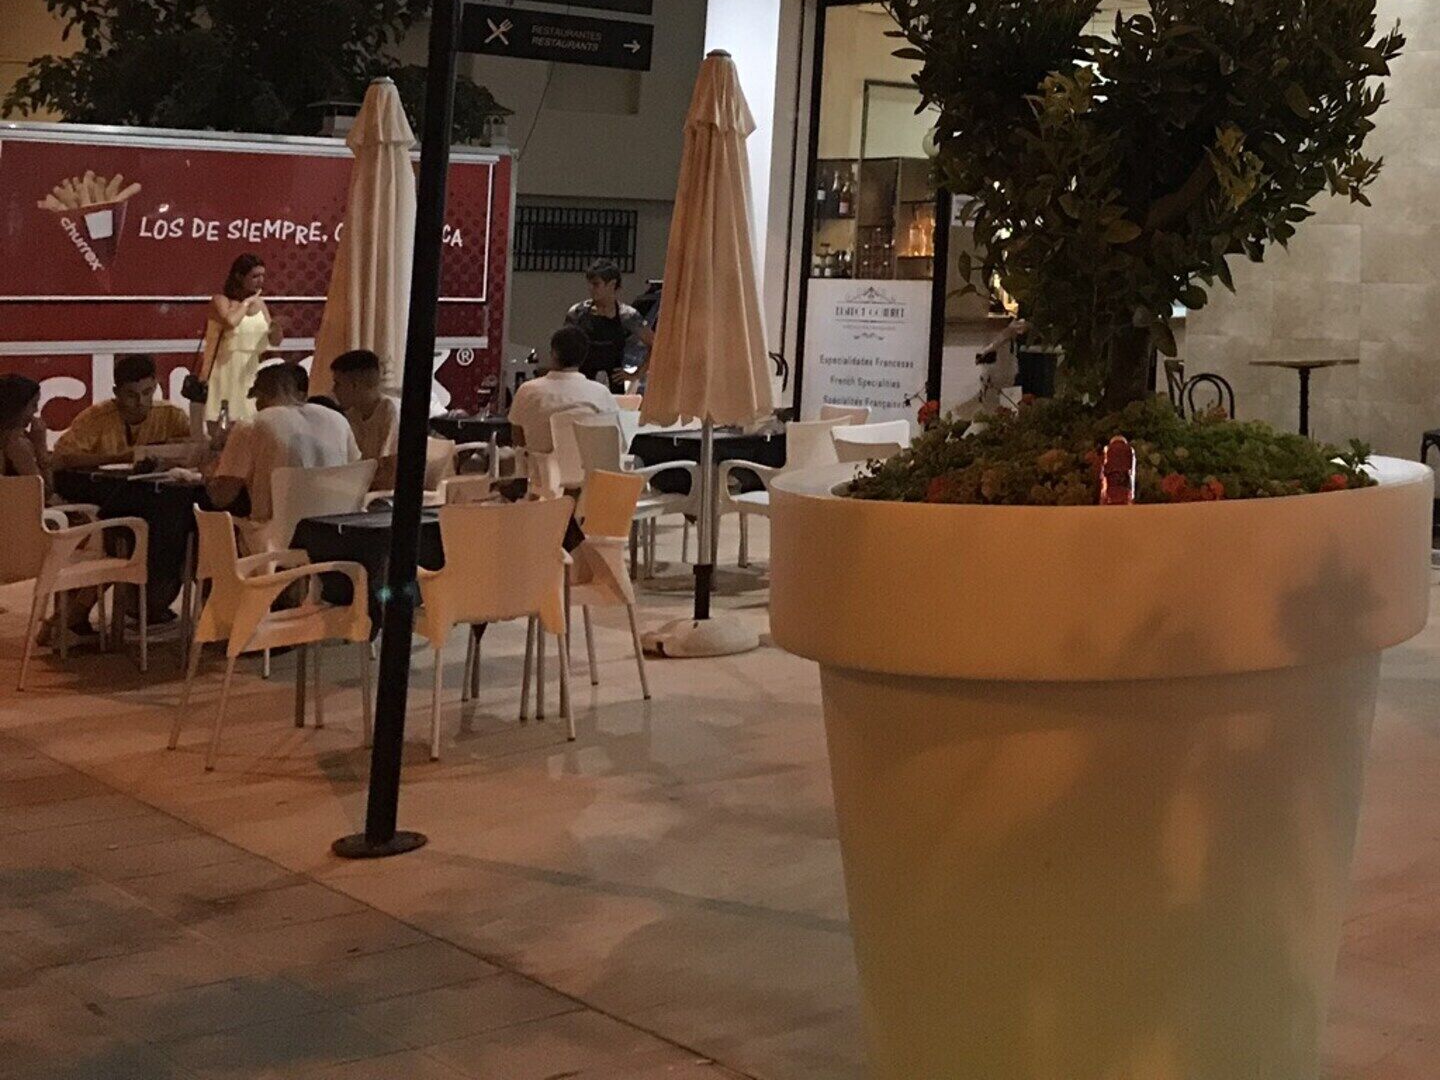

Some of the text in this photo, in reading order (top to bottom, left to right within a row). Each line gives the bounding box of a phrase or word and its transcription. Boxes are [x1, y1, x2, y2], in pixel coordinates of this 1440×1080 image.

[530, 36, 601, 53] RESTAURANTS
[60, 216, 104, 273] churrex
[139, 216, 184, 240] LOS
[191, 219, 220, 242] DE
[226, 220, 328, 245] SIEMPRE,
